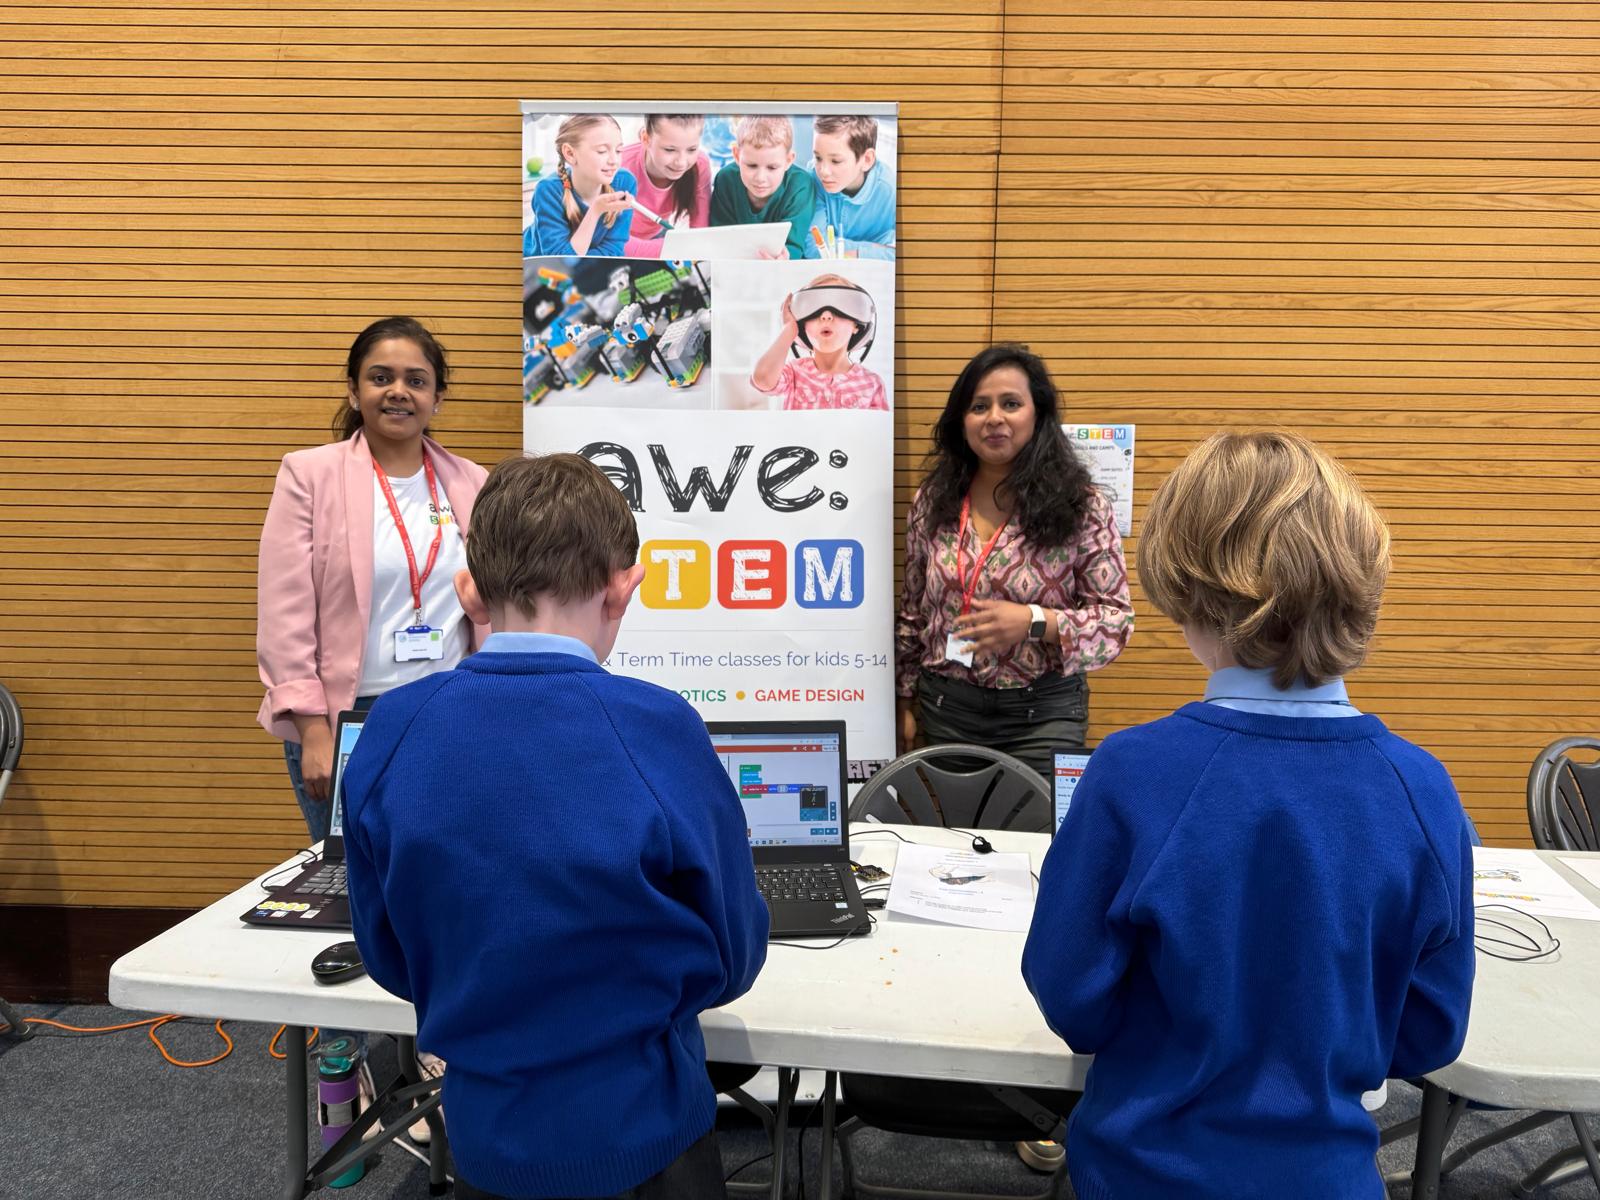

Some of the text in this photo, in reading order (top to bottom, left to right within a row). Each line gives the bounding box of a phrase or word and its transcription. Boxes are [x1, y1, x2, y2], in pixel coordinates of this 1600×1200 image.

[1079, 429, 1125, 440] STEM
[650, 547, 854, 602] TEM
[617, 652, 664, 667] Term
[669, 651, 713, 667] Time
[718, 651, 783, 667] classes
[786, 651, 811, 667] for
[815, 651, 850, 667] kids
[854, 654, 888, 668] 5-14
[679, 689, 865, 702] OTICS GAME DESIGN
